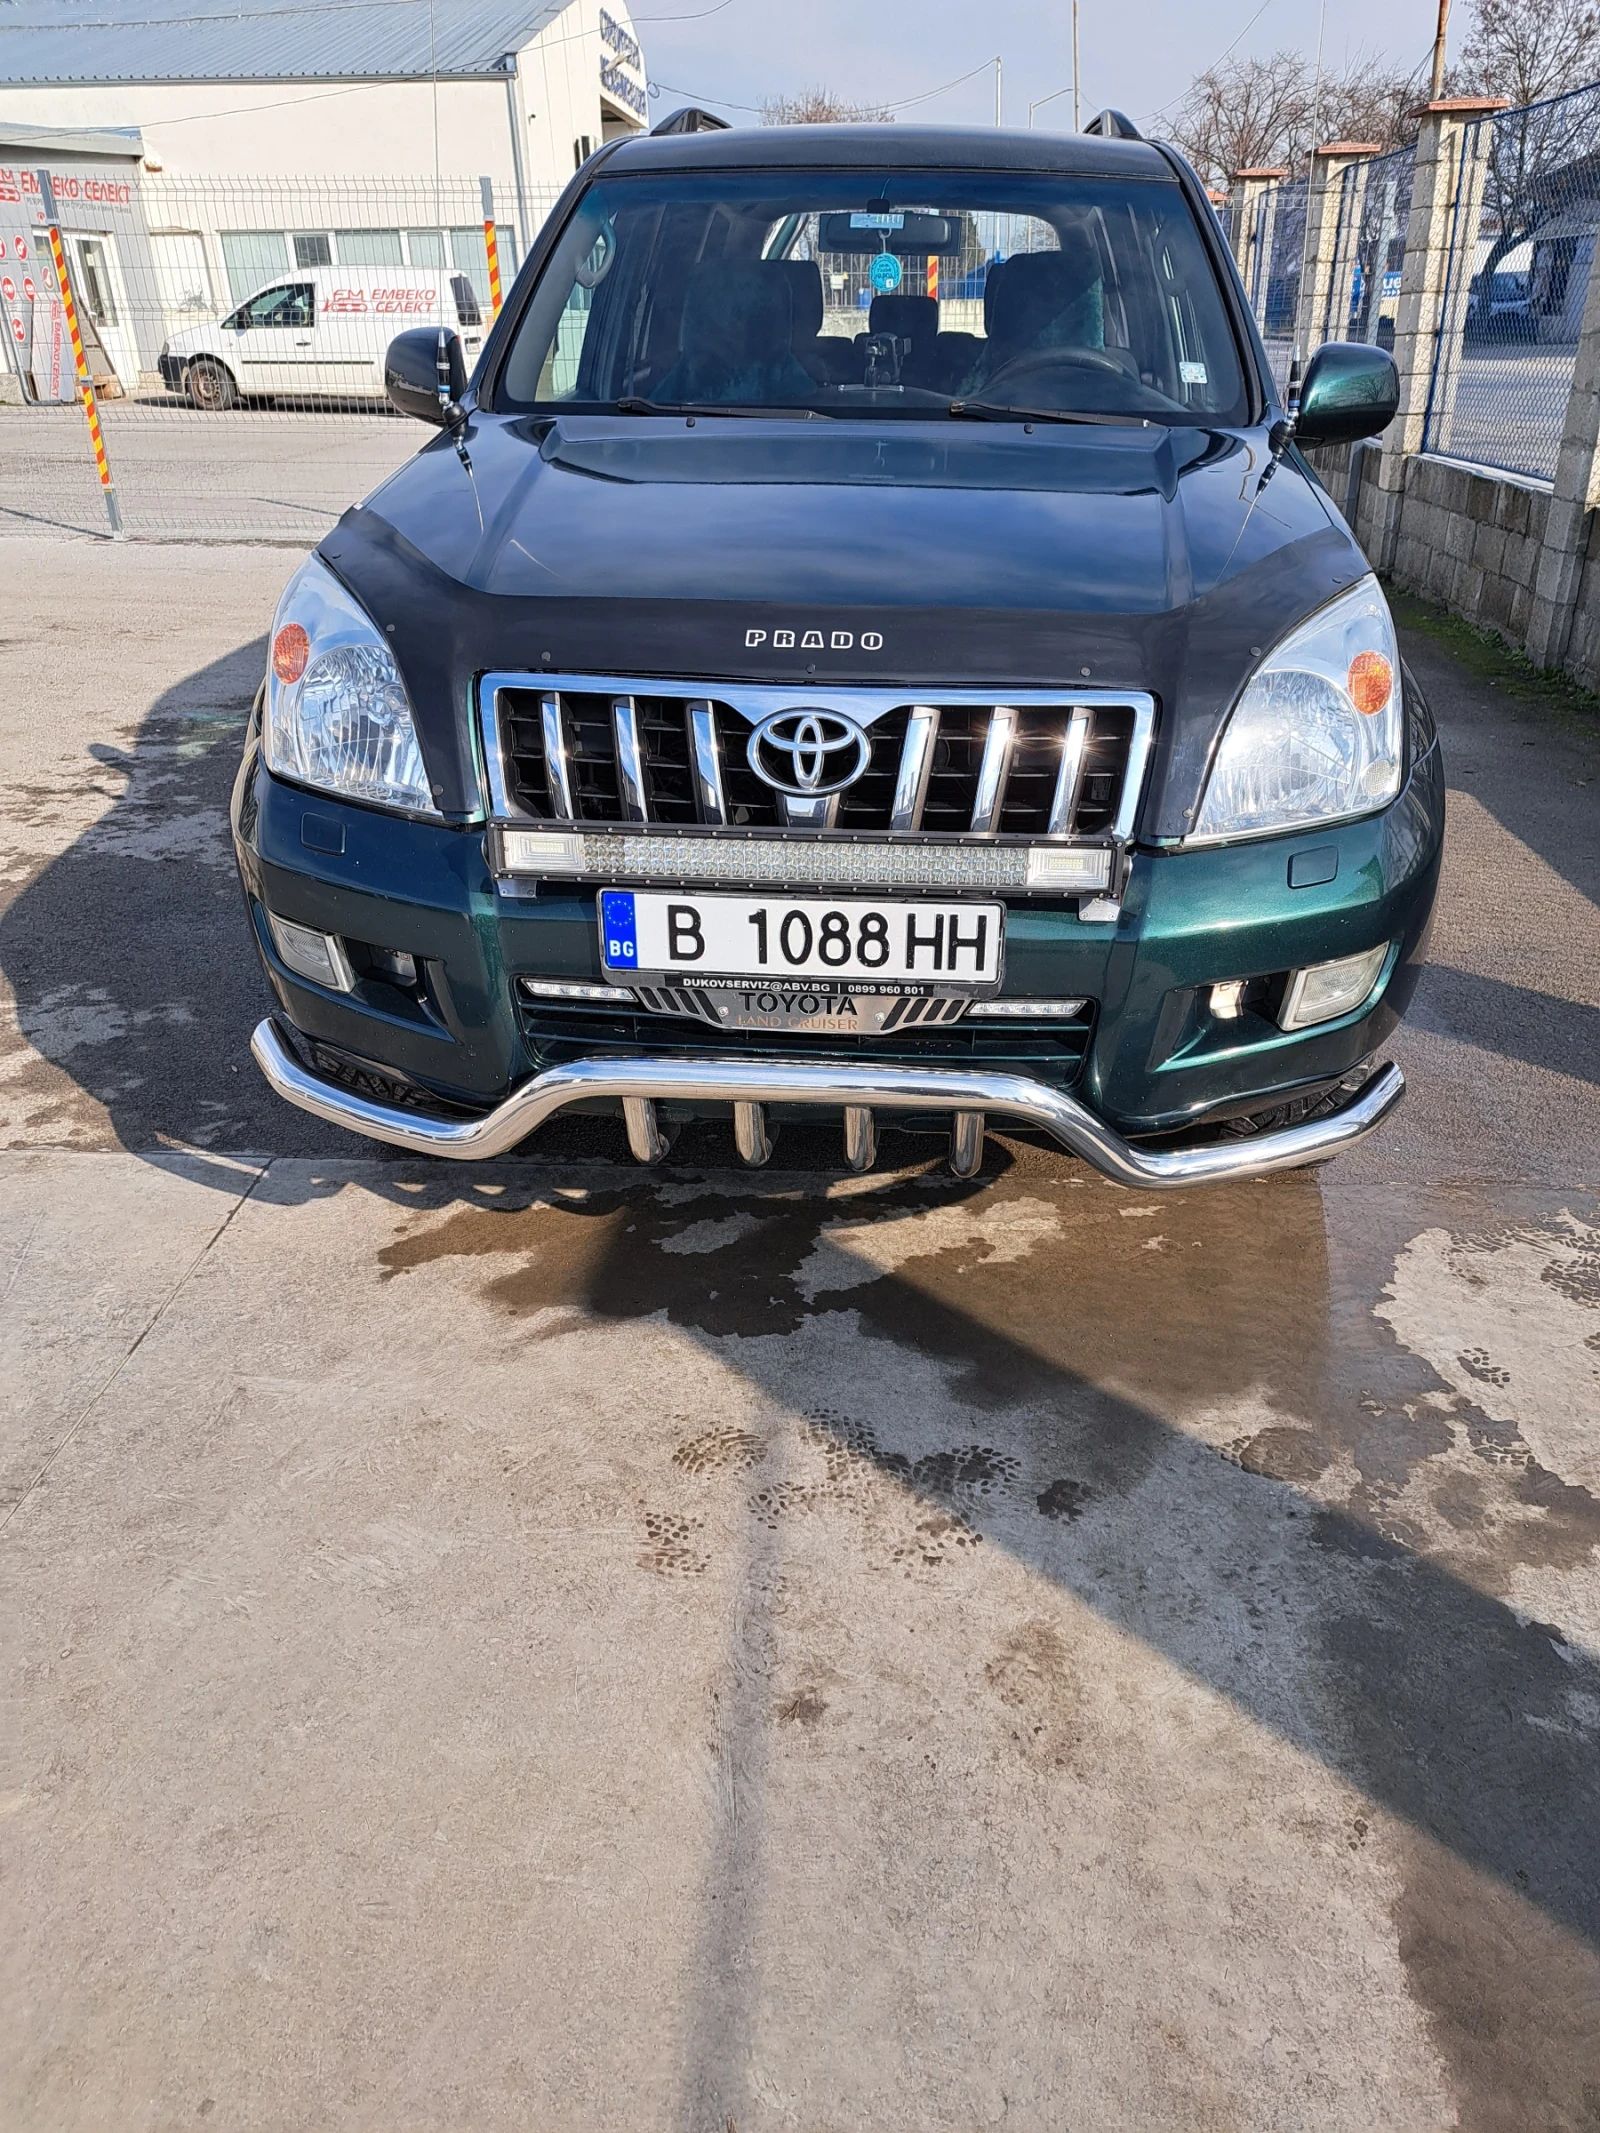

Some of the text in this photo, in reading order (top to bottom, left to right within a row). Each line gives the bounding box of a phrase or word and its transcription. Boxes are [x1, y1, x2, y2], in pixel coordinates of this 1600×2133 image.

[20, 170, 131, 205] ЕМЕКО СЕЛЕКТ
[371, 288, 436, 301] ЕМВЕКО
[375, 302, 436, 313] СЕЛЕКТ
[745, 629, 884, 651] PRADO
[667, 904, 987, 972] B 1088 HH
[610, 940, 634, 958] BG
[683, 978, 925, 995] DUKOVSERVIZ@ABV.BG 0899 960 801
[738, 992, 858, 1016] TOYOTA
[738, 1015, 858, 1031] LAND CRUISER
